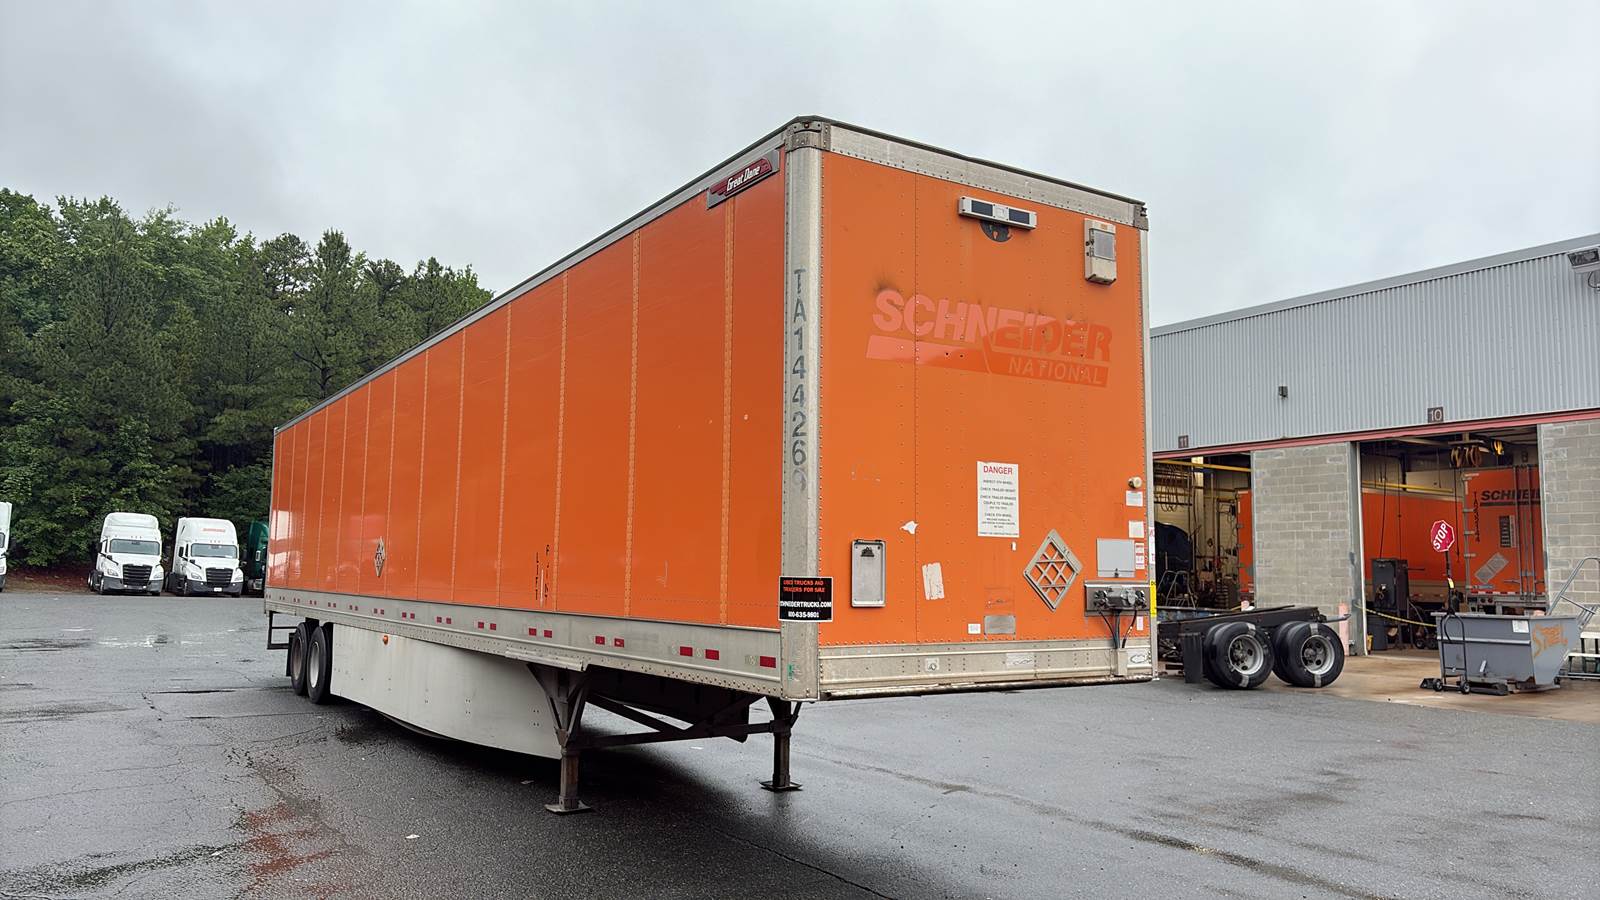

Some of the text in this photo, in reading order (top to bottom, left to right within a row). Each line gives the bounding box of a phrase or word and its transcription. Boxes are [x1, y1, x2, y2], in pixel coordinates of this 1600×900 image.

[727, 166, 761, 192] Great Dane
[872, 289, 1113, 363] SCHNEIDER
[1008, 356, 1105, 384] NATIONAL
[1431, 408, 1443, 421] 10
[1179, 436, 1188, 448] 11
[983, 465, 1013, 475] DANGER
[1433, 522, 1449, 550] STOP
